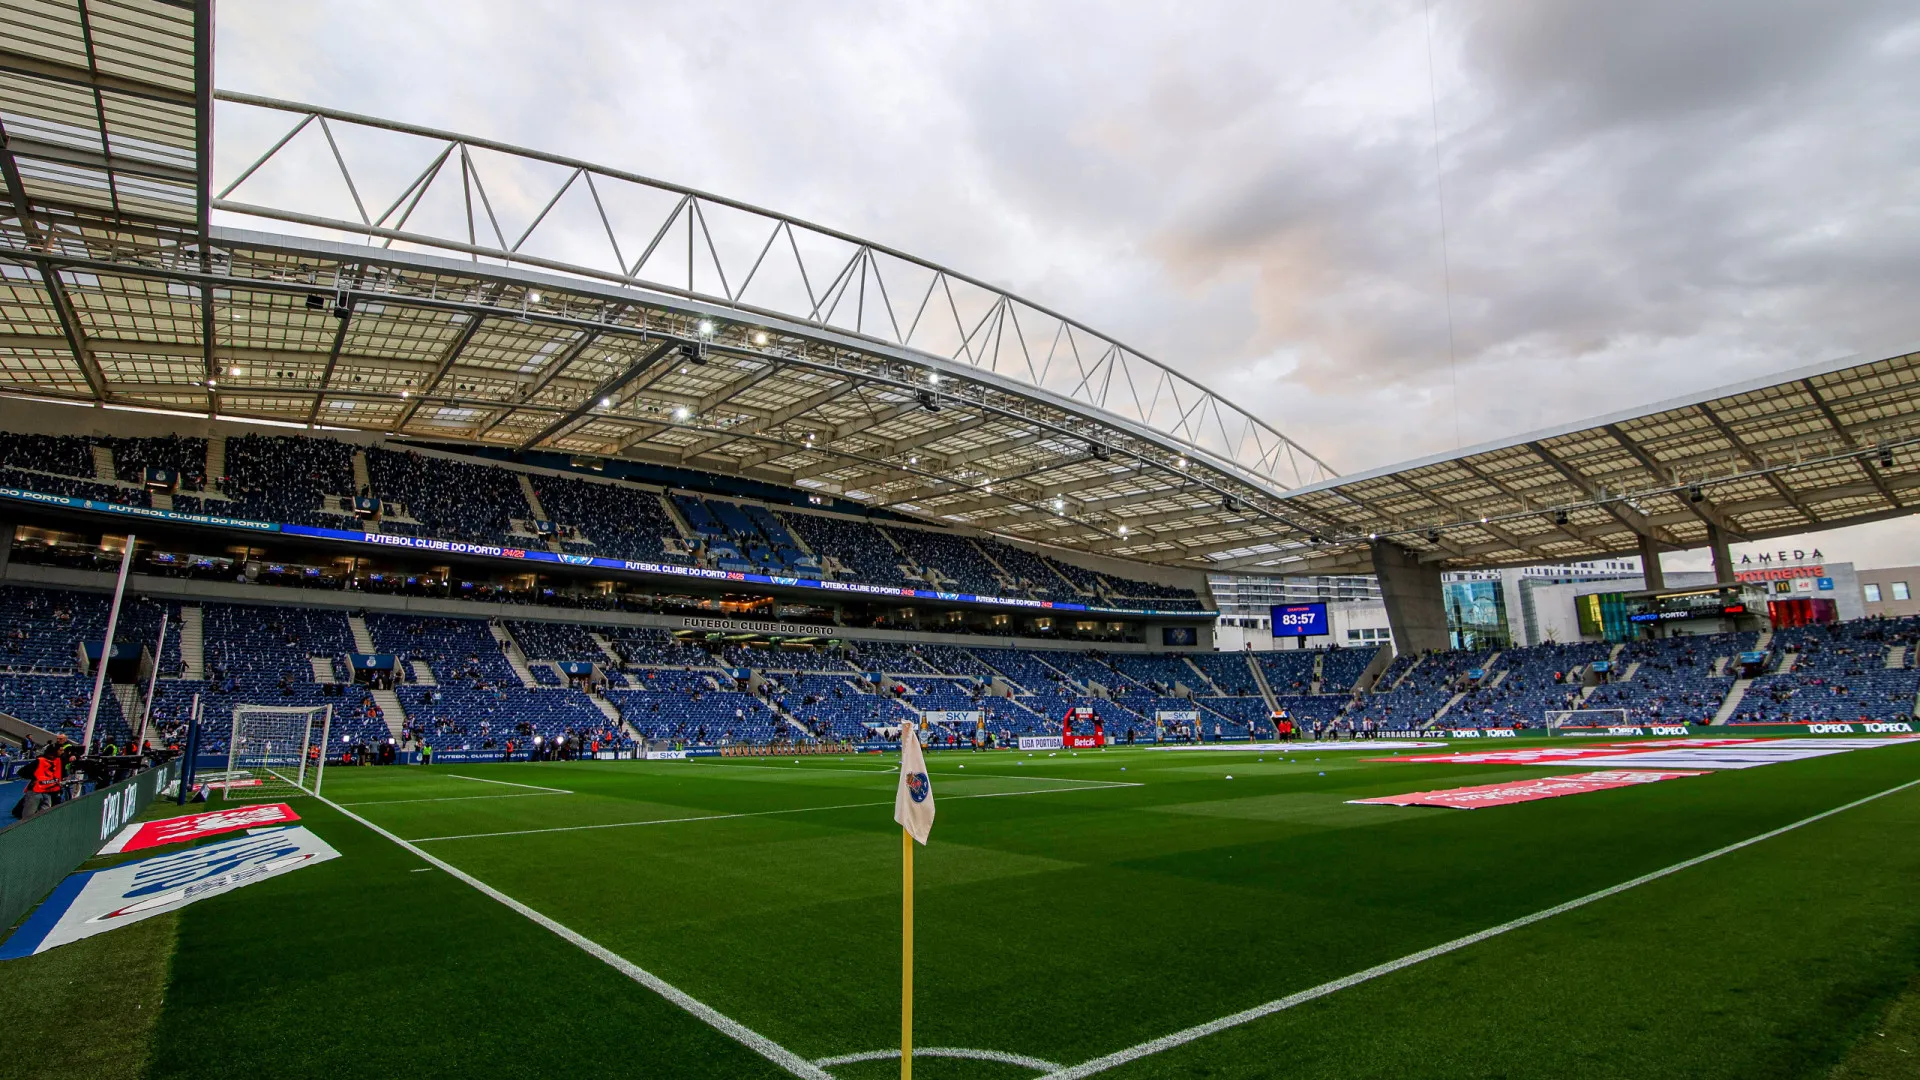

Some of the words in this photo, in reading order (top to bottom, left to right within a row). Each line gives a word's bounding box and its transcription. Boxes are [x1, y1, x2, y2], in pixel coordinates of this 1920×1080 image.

[23, 490, 70, 504] PORTO
[108, 504, 166, 517] FUTEBOL
[168, 512, 208, 522] CLUBE
[230, 519, 270, 529] PORTO
[365, 533, 414, 547] FUTEBOL
[416, 538, 449, 550] CLUBE
[451, 543, 466, 552] DO
[468, 544, 500, 556] PORTO
[502, 548, 525, 558] 24/25
[1731, 548, 1823, 564] AMEDA
[626, 562, 661, 572] FUTEBOL
[662, 564, 688, 574] CLUBE
[689, 568, 700, 576] DO
[702, 569, 726, 578] PORTO
[1733, 566, 1824, 582] ONTINENTE
[821, 581, 848, 590] FUTEBOL
[850, 584, 870, 592] CLUBE
[976, 596, 999, 604] FUTEBOL
[1282, 613, 1315, 625] 83:57
[1660, 611, 1688, 619] PORTO!
[683, 618, 736, 630] FUTEBOL
[740, 622, 776, 632] CLUBE
[780, 624, 795, 633] DO
[799, 626, 834, 635] PORTO
[946, 712, 969, 721] SKY
[1651, 727, 1688, 735] TOPECA
[1808, 724, 1854, 733] TOPECA
[1863, 723, 1912, 732] TOPECA
[1423, 730, 1445, 738] ATZ
[1452, 730, 1480, 738] TOPECA
[1022, 739, 1034, 748] LIGA
